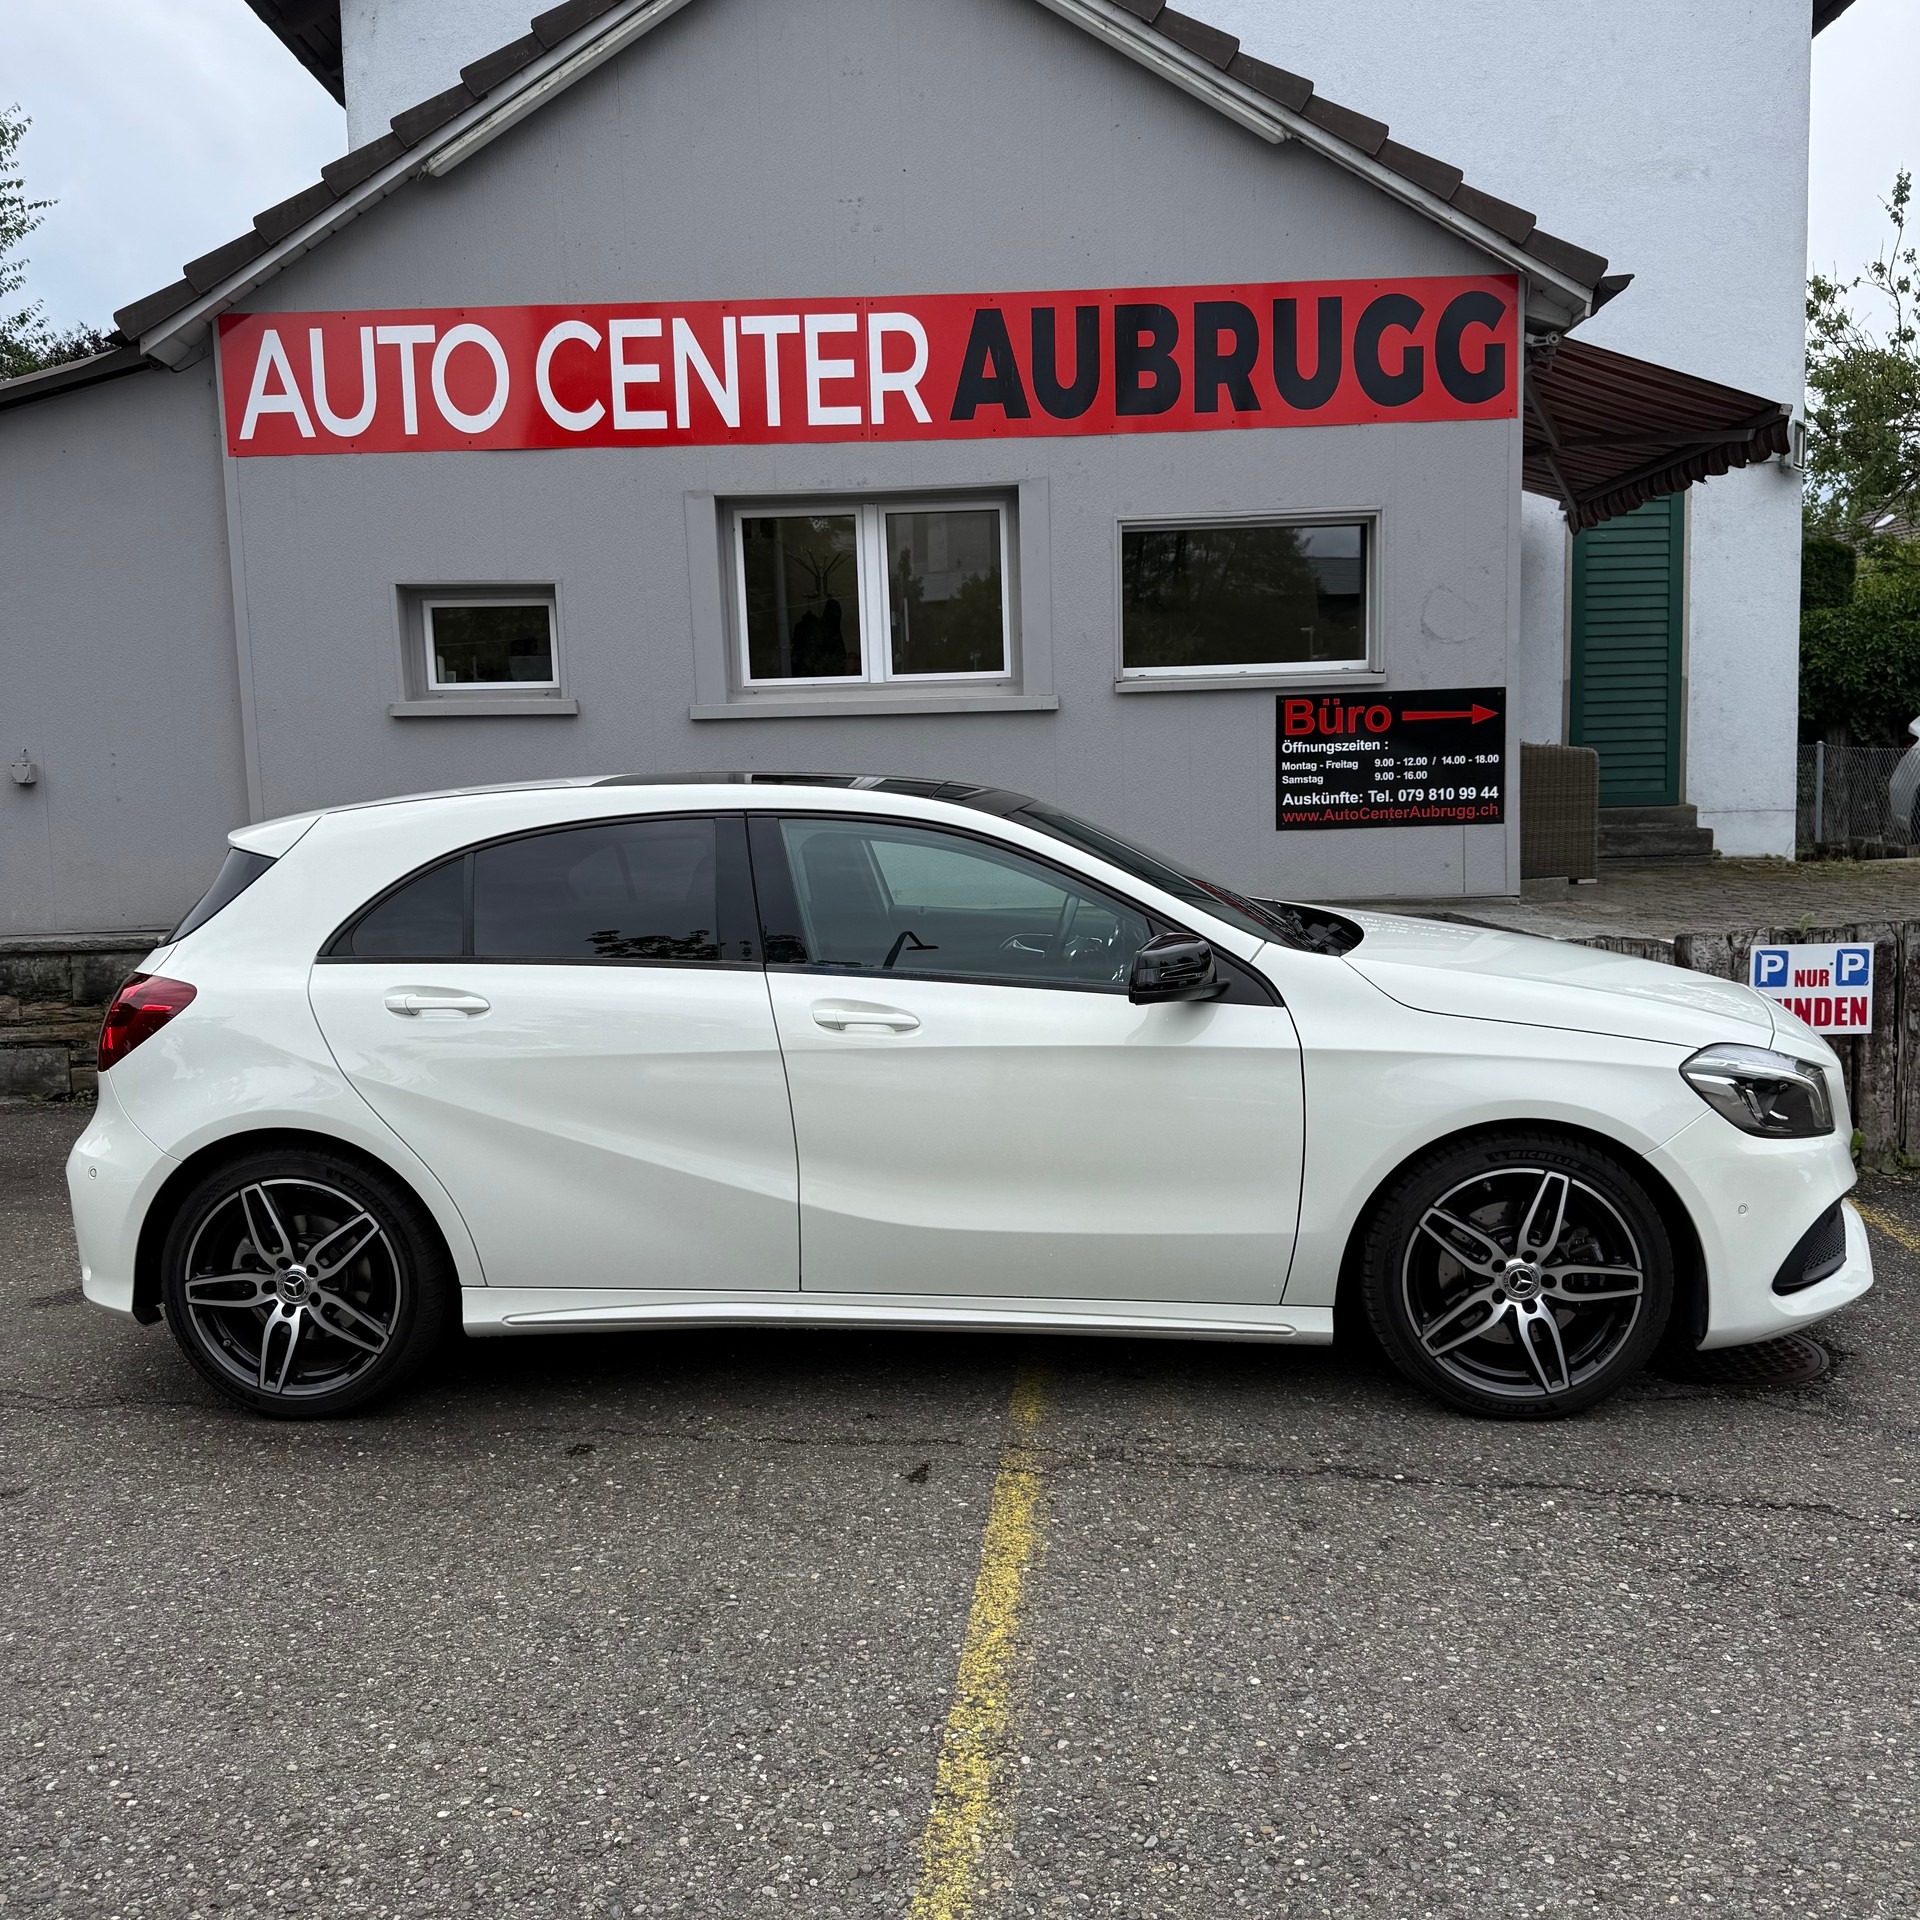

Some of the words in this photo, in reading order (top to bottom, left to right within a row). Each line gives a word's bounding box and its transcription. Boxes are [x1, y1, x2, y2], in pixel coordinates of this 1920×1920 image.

[239, 322, 510, 440] AUTO
[535, 311, 933, 433] CENTER
[949, 290, 1507, 421] AUBRUGG
[1284, 698, 1393, 736] Büro
[1281, 739, 1381, 755] Öffnungszeiten
[1281, 761, 1318, 772] Montag
[1325, 759, 1359, 771] Freitag
[1374, 758, 1394, 768] 9.00
[1402, 757, 1428, 767] 12.00
[1441, 755, 1466, 765] 14.00
[1474, 754, 1499, 764] 18.00
[1281, 775, 1324, 785] Samstag
[1374, 772, 1394, 781] 9.00
[1403, 770, 1428, 780] 16.00
[1282, 790, 1364, 806] Auskünfte:
[1367, 789, 1394, 803] Tel.
[1397, 788, 1425, 802] 079
[1428, 787, 1455, 801] 810
[1458, 786, 1477, 800] 99
[1480, 785, 1499, 799] 44
[1282, 802, 1499, 822] www.AutoCenterAubrugg.ch
[1794, 969, 1830, 988] NUR
[1774, 996, 1868, 1027] NDEN
[1508, 1150, 1581, 1169] MICHELIN
